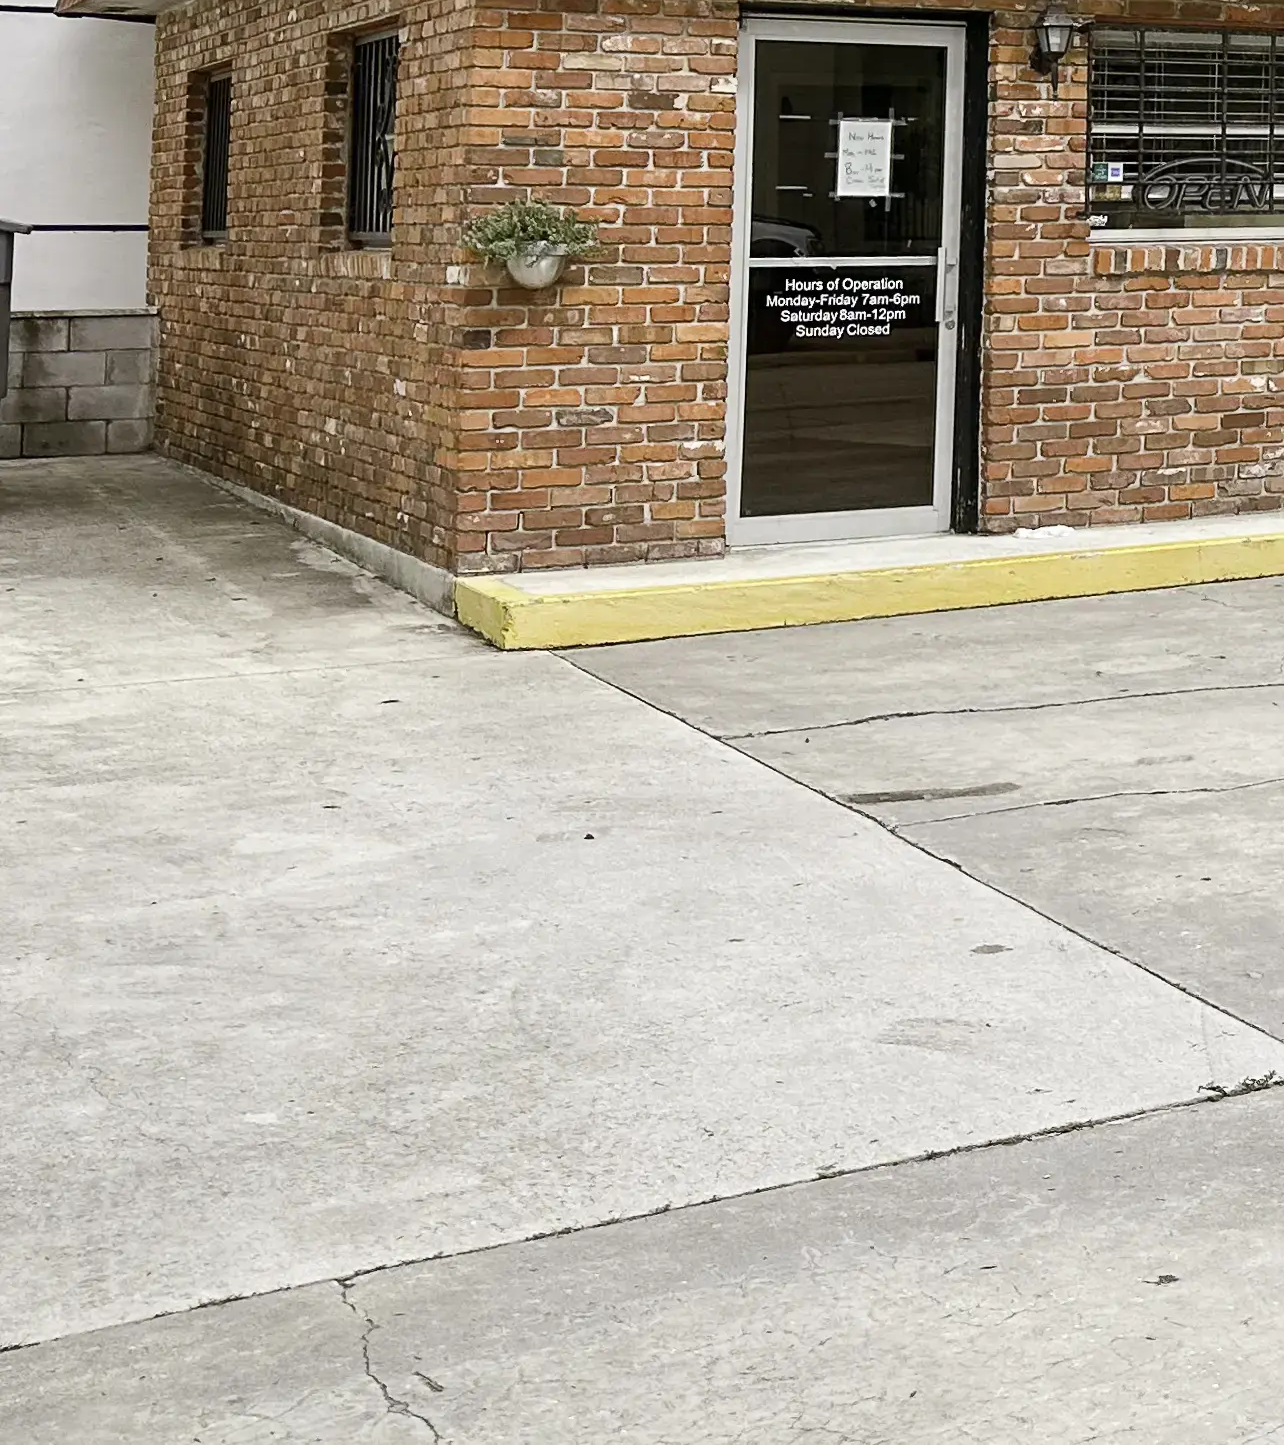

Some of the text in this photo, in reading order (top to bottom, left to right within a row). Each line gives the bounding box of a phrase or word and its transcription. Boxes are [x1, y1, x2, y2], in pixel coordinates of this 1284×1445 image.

[1144, 175, 1269, 210] OPEN
[785, 277, 904, 292] Hours of Operation
[766, 293, 920, 308] Monday-Friday 7am-6pm
[781, 308, 906, 324] Saturday 8am-12pm
[796, 323, 890, 339] Sunday Closed
